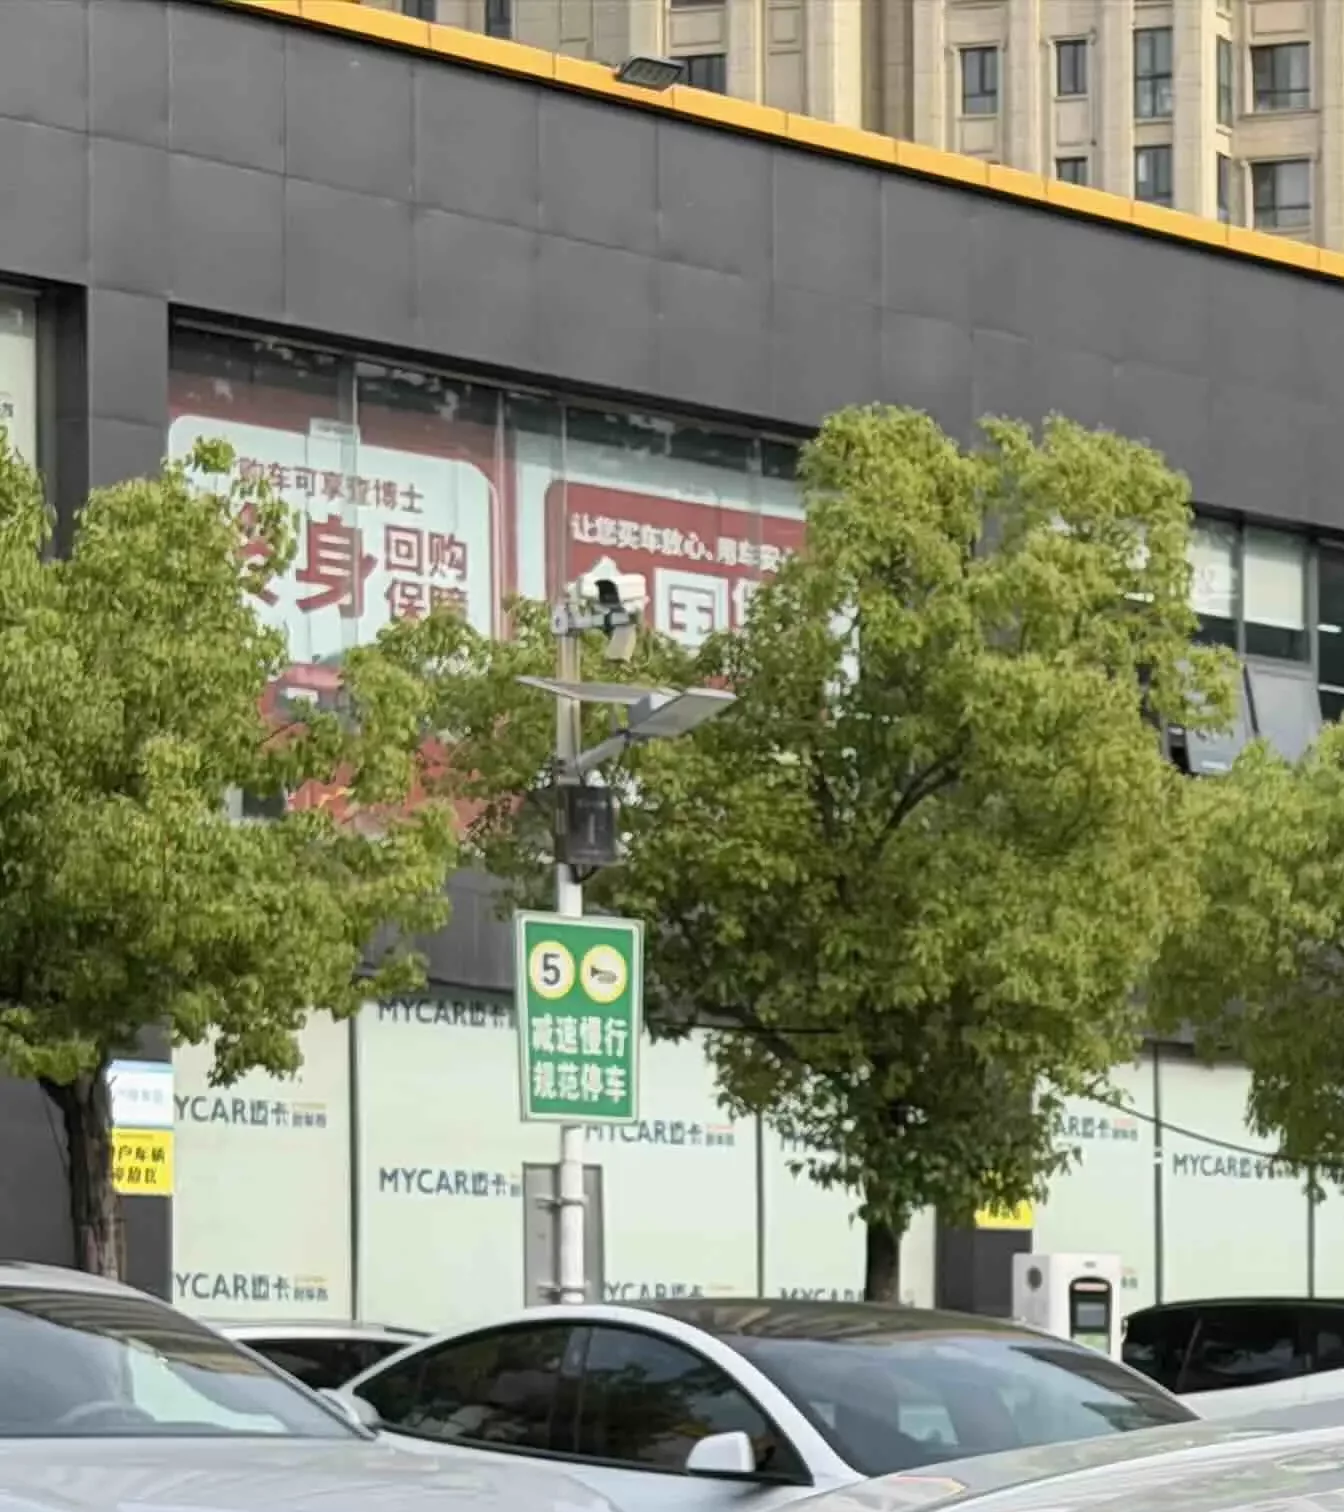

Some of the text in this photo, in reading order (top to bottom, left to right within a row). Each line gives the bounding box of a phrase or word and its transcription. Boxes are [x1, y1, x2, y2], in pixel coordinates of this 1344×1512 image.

[384, 524, 468, 581] 回购
[571, 512, 794, 573] 让您买车放心、用车安
[542, 952, 561, 986] 5
[531, 1013, 628, 1057] 减速慢行
[533, 1061, 627, 1104] 规范停车
